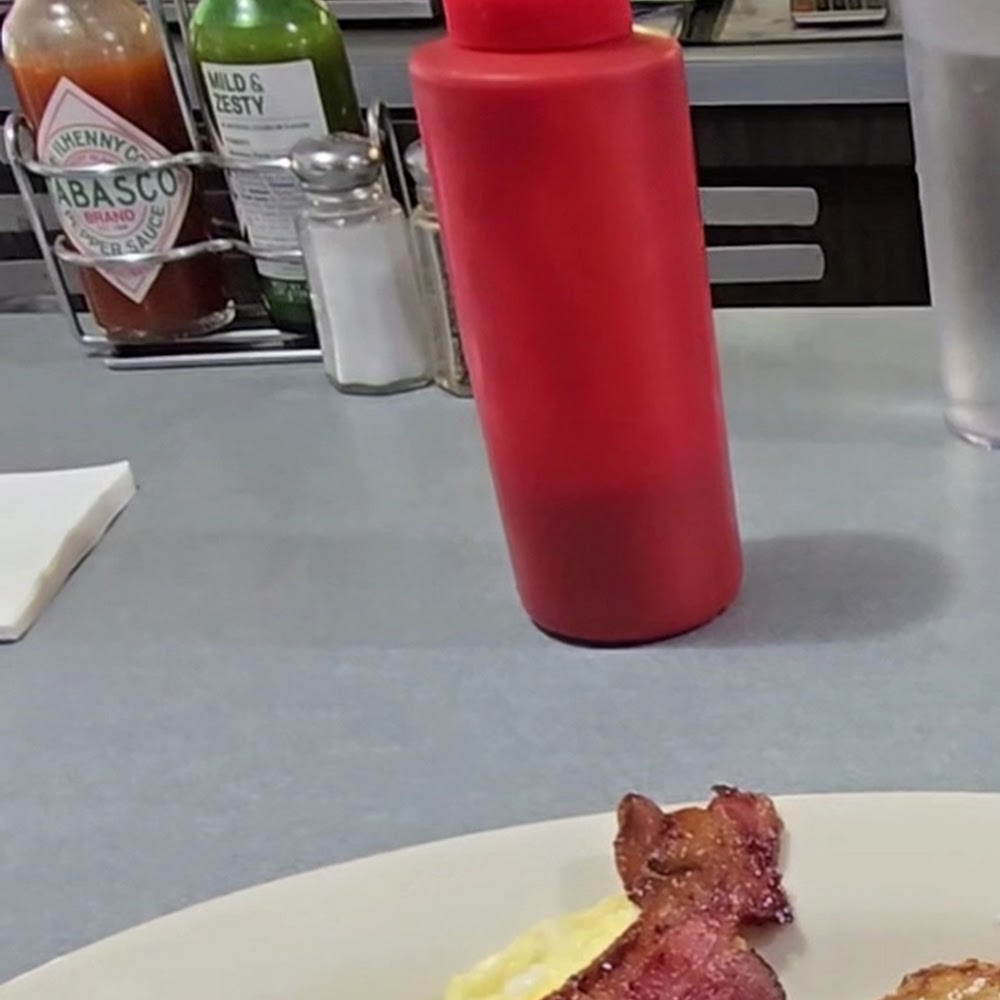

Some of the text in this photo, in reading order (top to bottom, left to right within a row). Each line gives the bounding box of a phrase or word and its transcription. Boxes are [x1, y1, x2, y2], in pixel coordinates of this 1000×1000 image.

[207, 71, 264, 93] MILD &
[213, 92, 263, 115] ZESTY
[84, 209, 135, 224] BRAND
[126, 205, 164, 253] SAUCE
